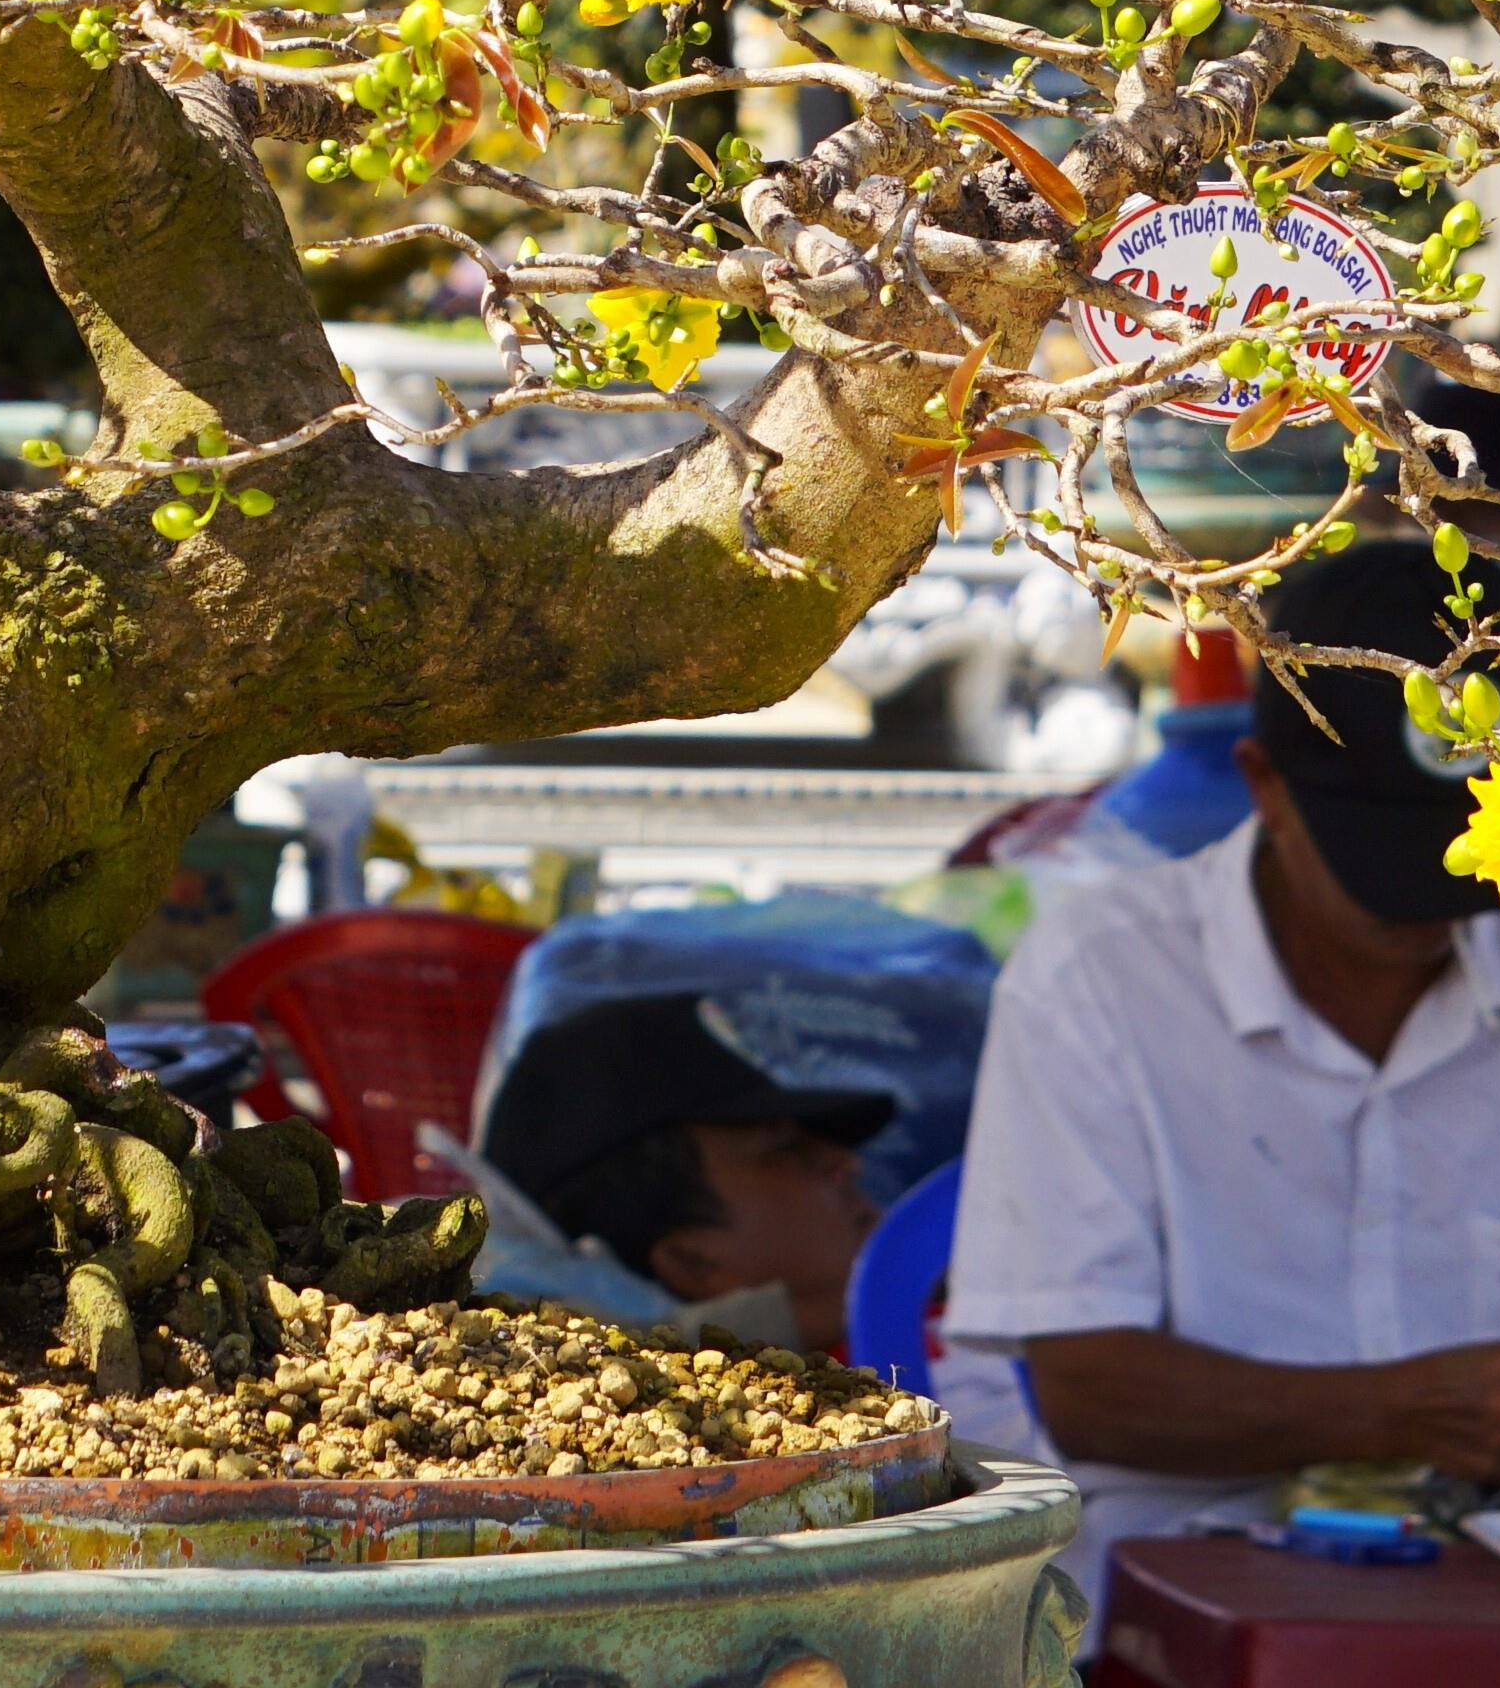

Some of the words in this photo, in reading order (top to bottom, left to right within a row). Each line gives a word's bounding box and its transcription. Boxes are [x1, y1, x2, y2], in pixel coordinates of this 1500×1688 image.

[1117, 212, 1166, 265] NGHỆ
[1169, 199, 1228, 238] THUẬT
[1312, 231, 1373, 296] BONSAI
